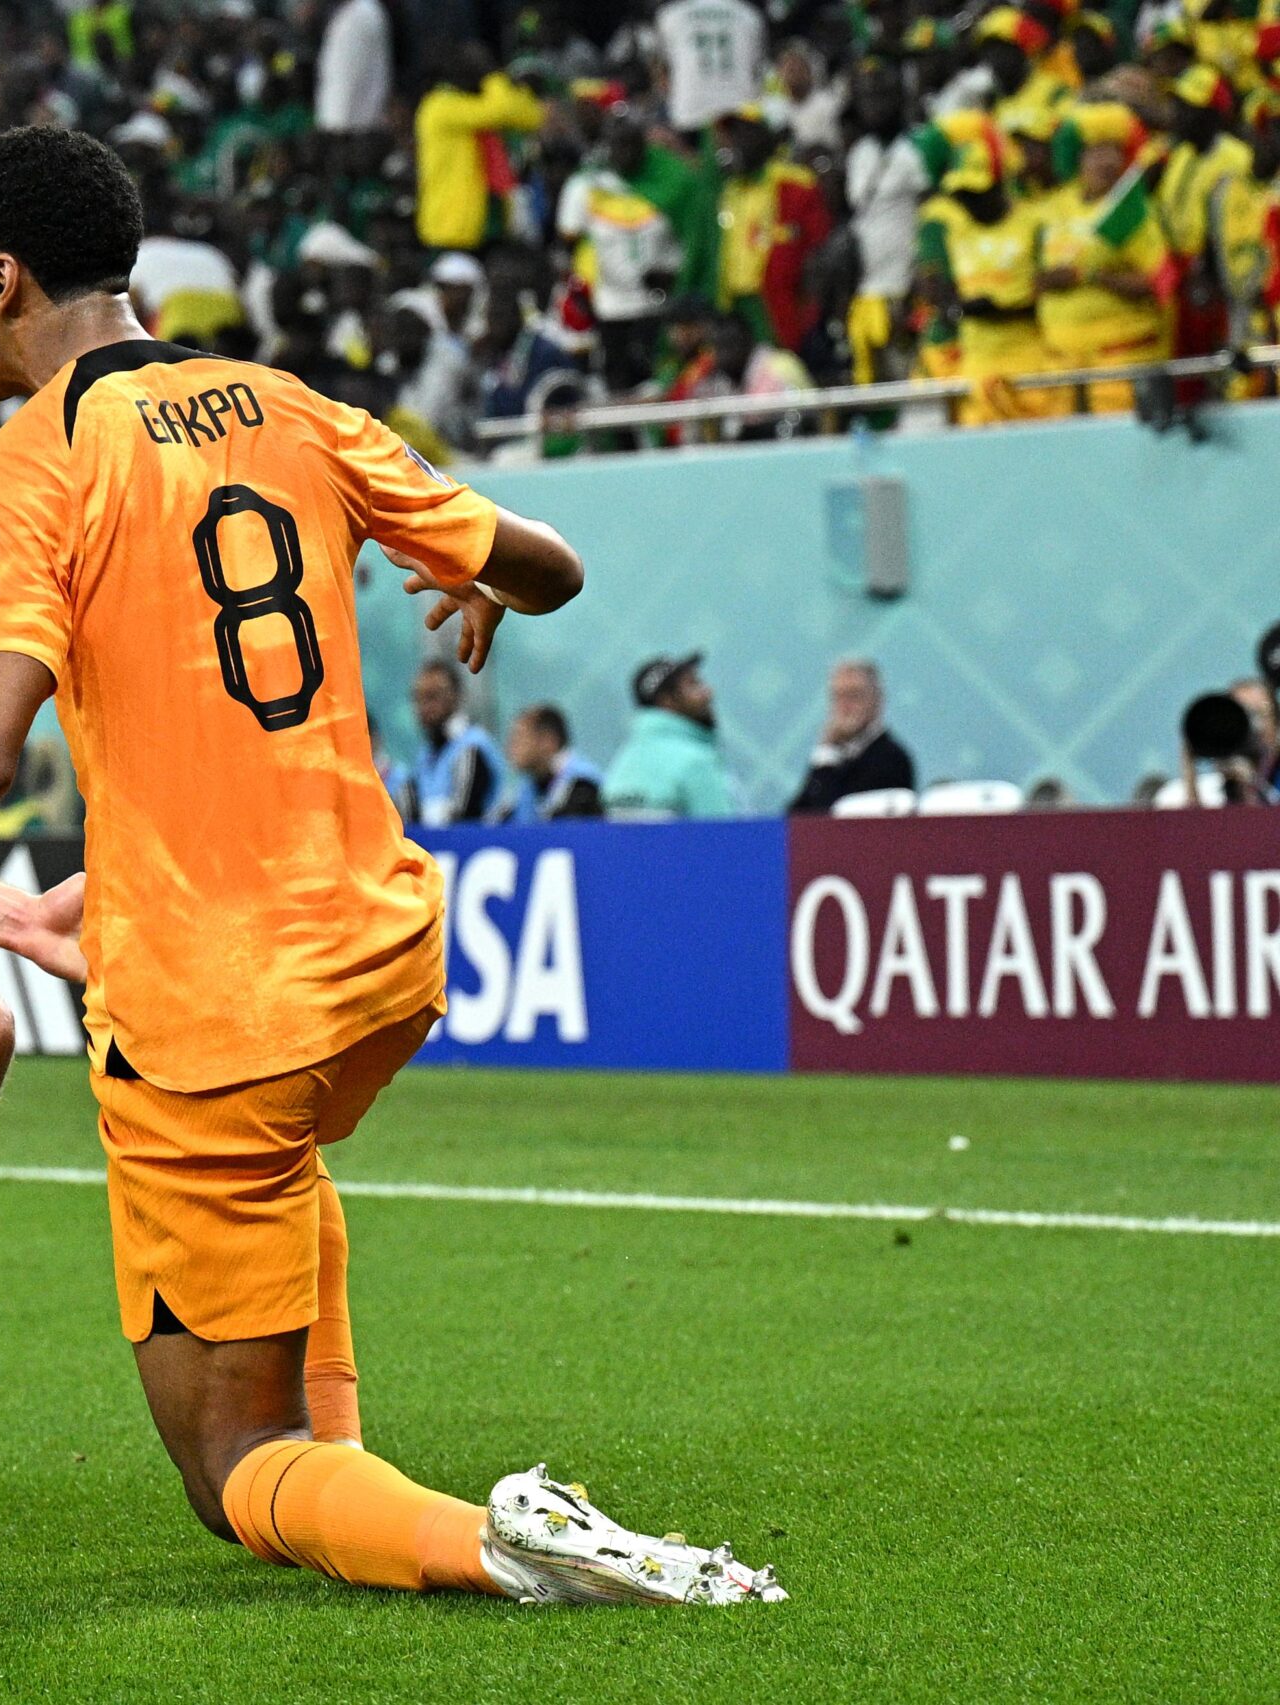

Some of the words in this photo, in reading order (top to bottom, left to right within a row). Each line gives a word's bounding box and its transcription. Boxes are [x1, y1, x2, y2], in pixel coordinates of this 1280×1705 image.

[135, 382, 264, 448] GAKPO
[192, 483, 324, 732] 8
[426, 846, 589, 1044] SA
[789, 872, 1116, 1034] QATAR
